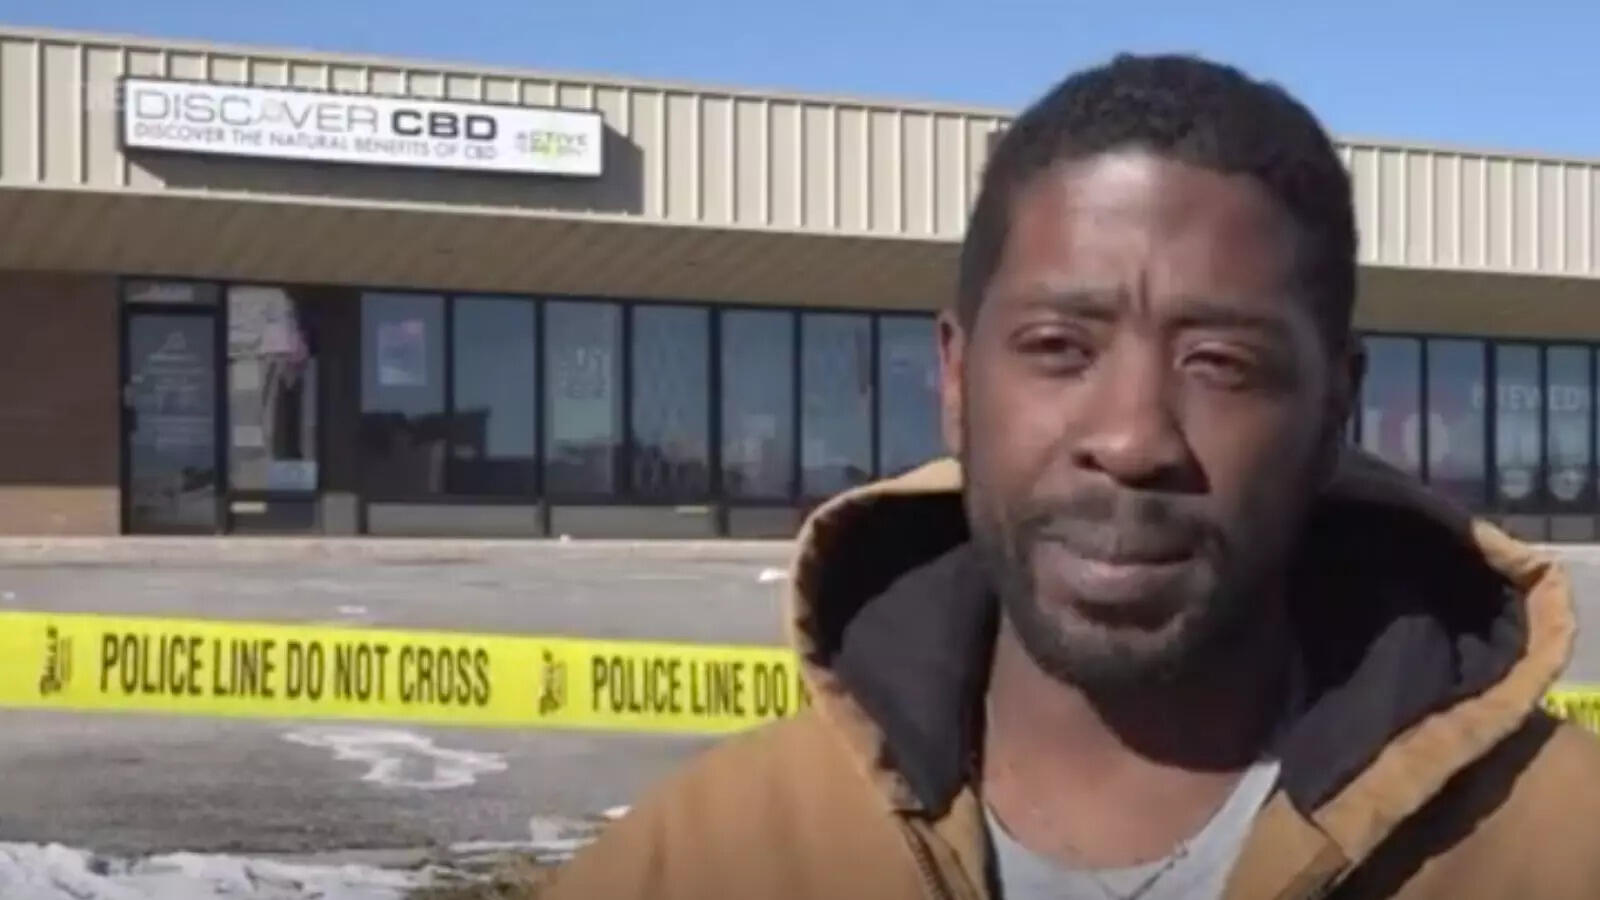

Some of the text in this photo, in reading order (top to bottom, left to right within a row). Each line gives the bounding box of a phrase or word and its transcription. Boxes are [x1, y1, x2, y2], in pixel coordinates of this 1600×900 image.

[134, 122, 225, 143] DISCOVER
[231, 129, 264, 146] THE
[270, 131, 348, 151] NATURAL
[355, 135, 430, 157] BENEFITS
[434, 142, 459, 158] OF
[464, 143, 498, 161] CBD
[390, 109, 498, 141] CBD
[100, 631, 205, 696] POLICE
[212, 637, 276, 698] LINE
[286, 639, 325, 700] DO
[334, 642, 391, 702] NOT
[400, 644, 490, 706] CROSS
[592, 654, 682, 714] POLICE
[690, 658, 746, 717] LINE
[753, 661, 789, 717] DO
